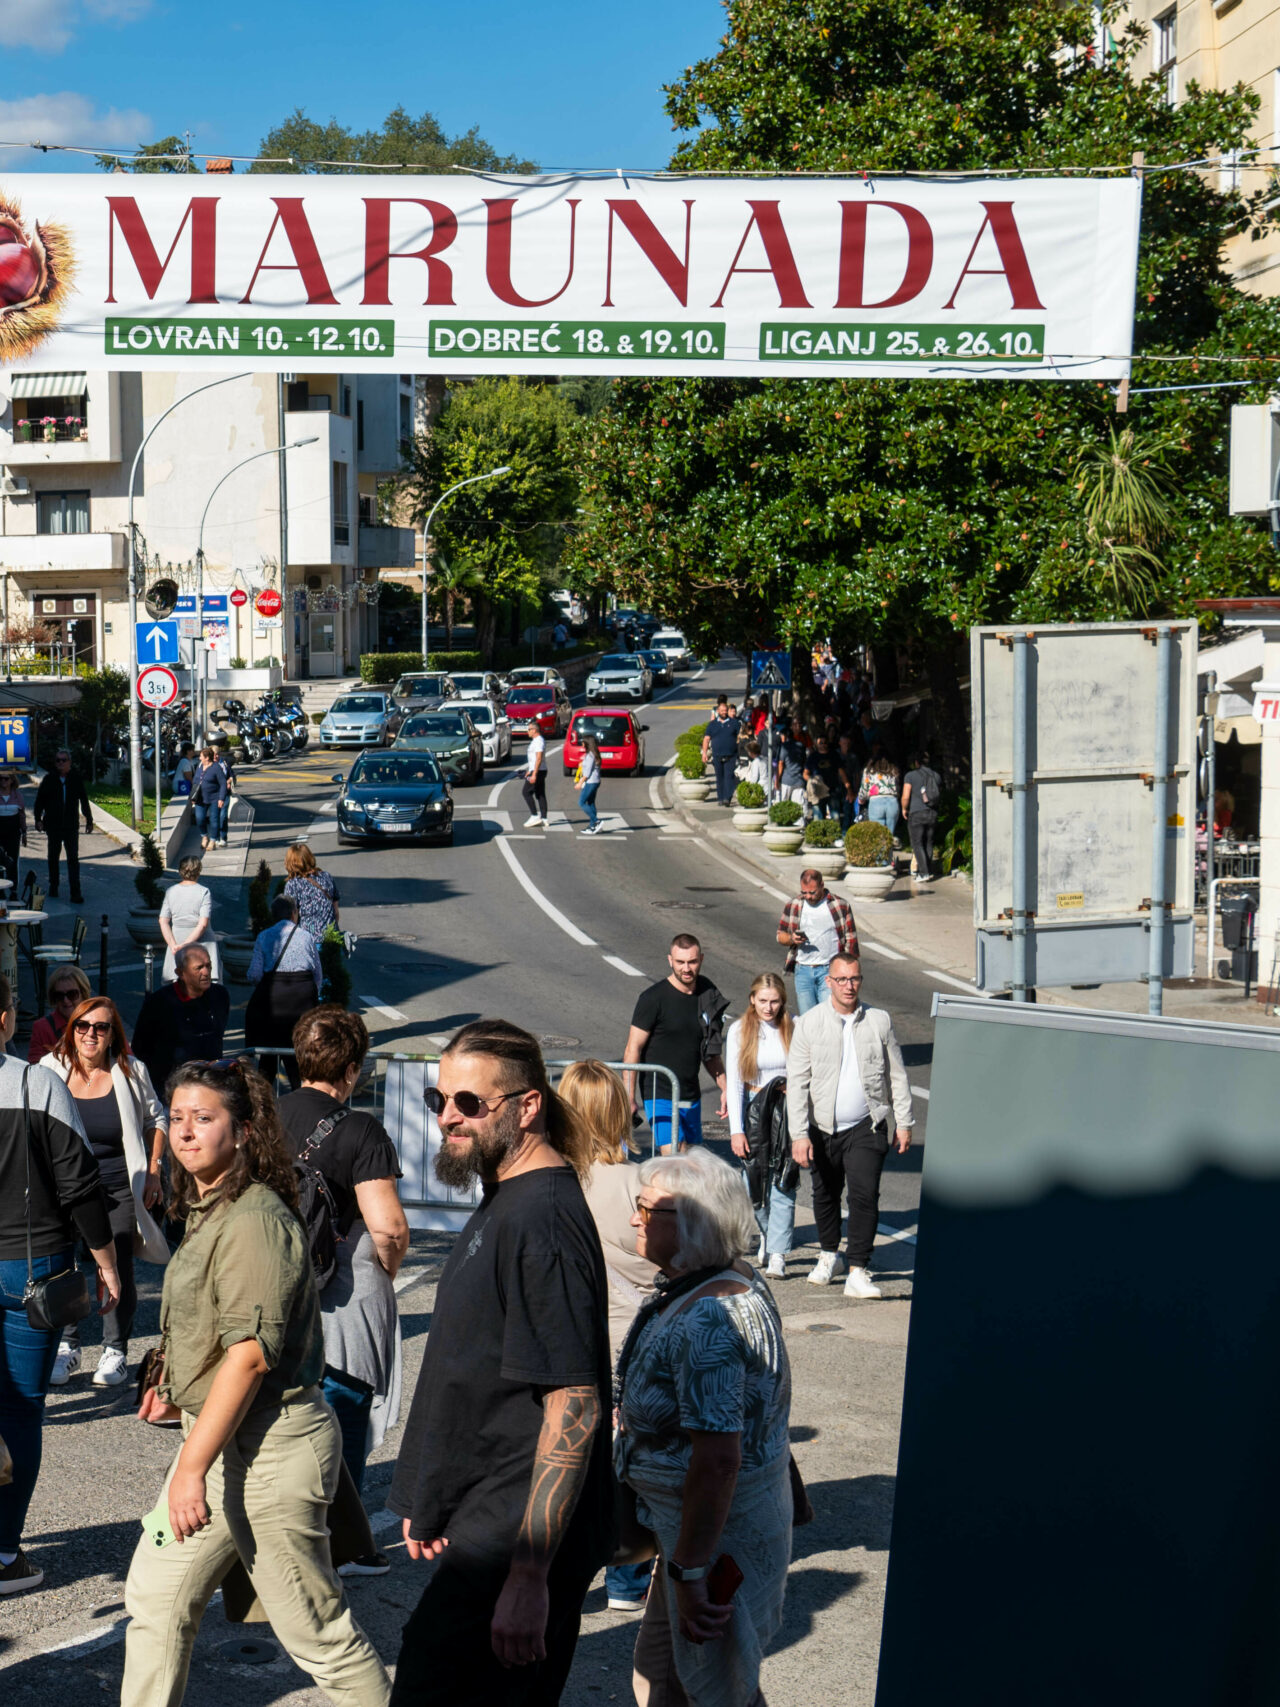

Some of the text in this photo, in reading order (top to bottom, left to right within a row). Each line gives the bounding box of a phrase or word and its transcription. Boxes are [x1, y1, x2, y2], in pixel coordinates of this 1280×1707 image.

[104, 195, 1048, 310] MARUNADA
[112, 325, 240, 350] LOVRAN
[251, 326, 289, 351] 10.
[434, 323, 719, 354] DOBREĆ 18. & 19.10.
[765, 330, 1039, 357] LIGANJ 25. & 26.10.
